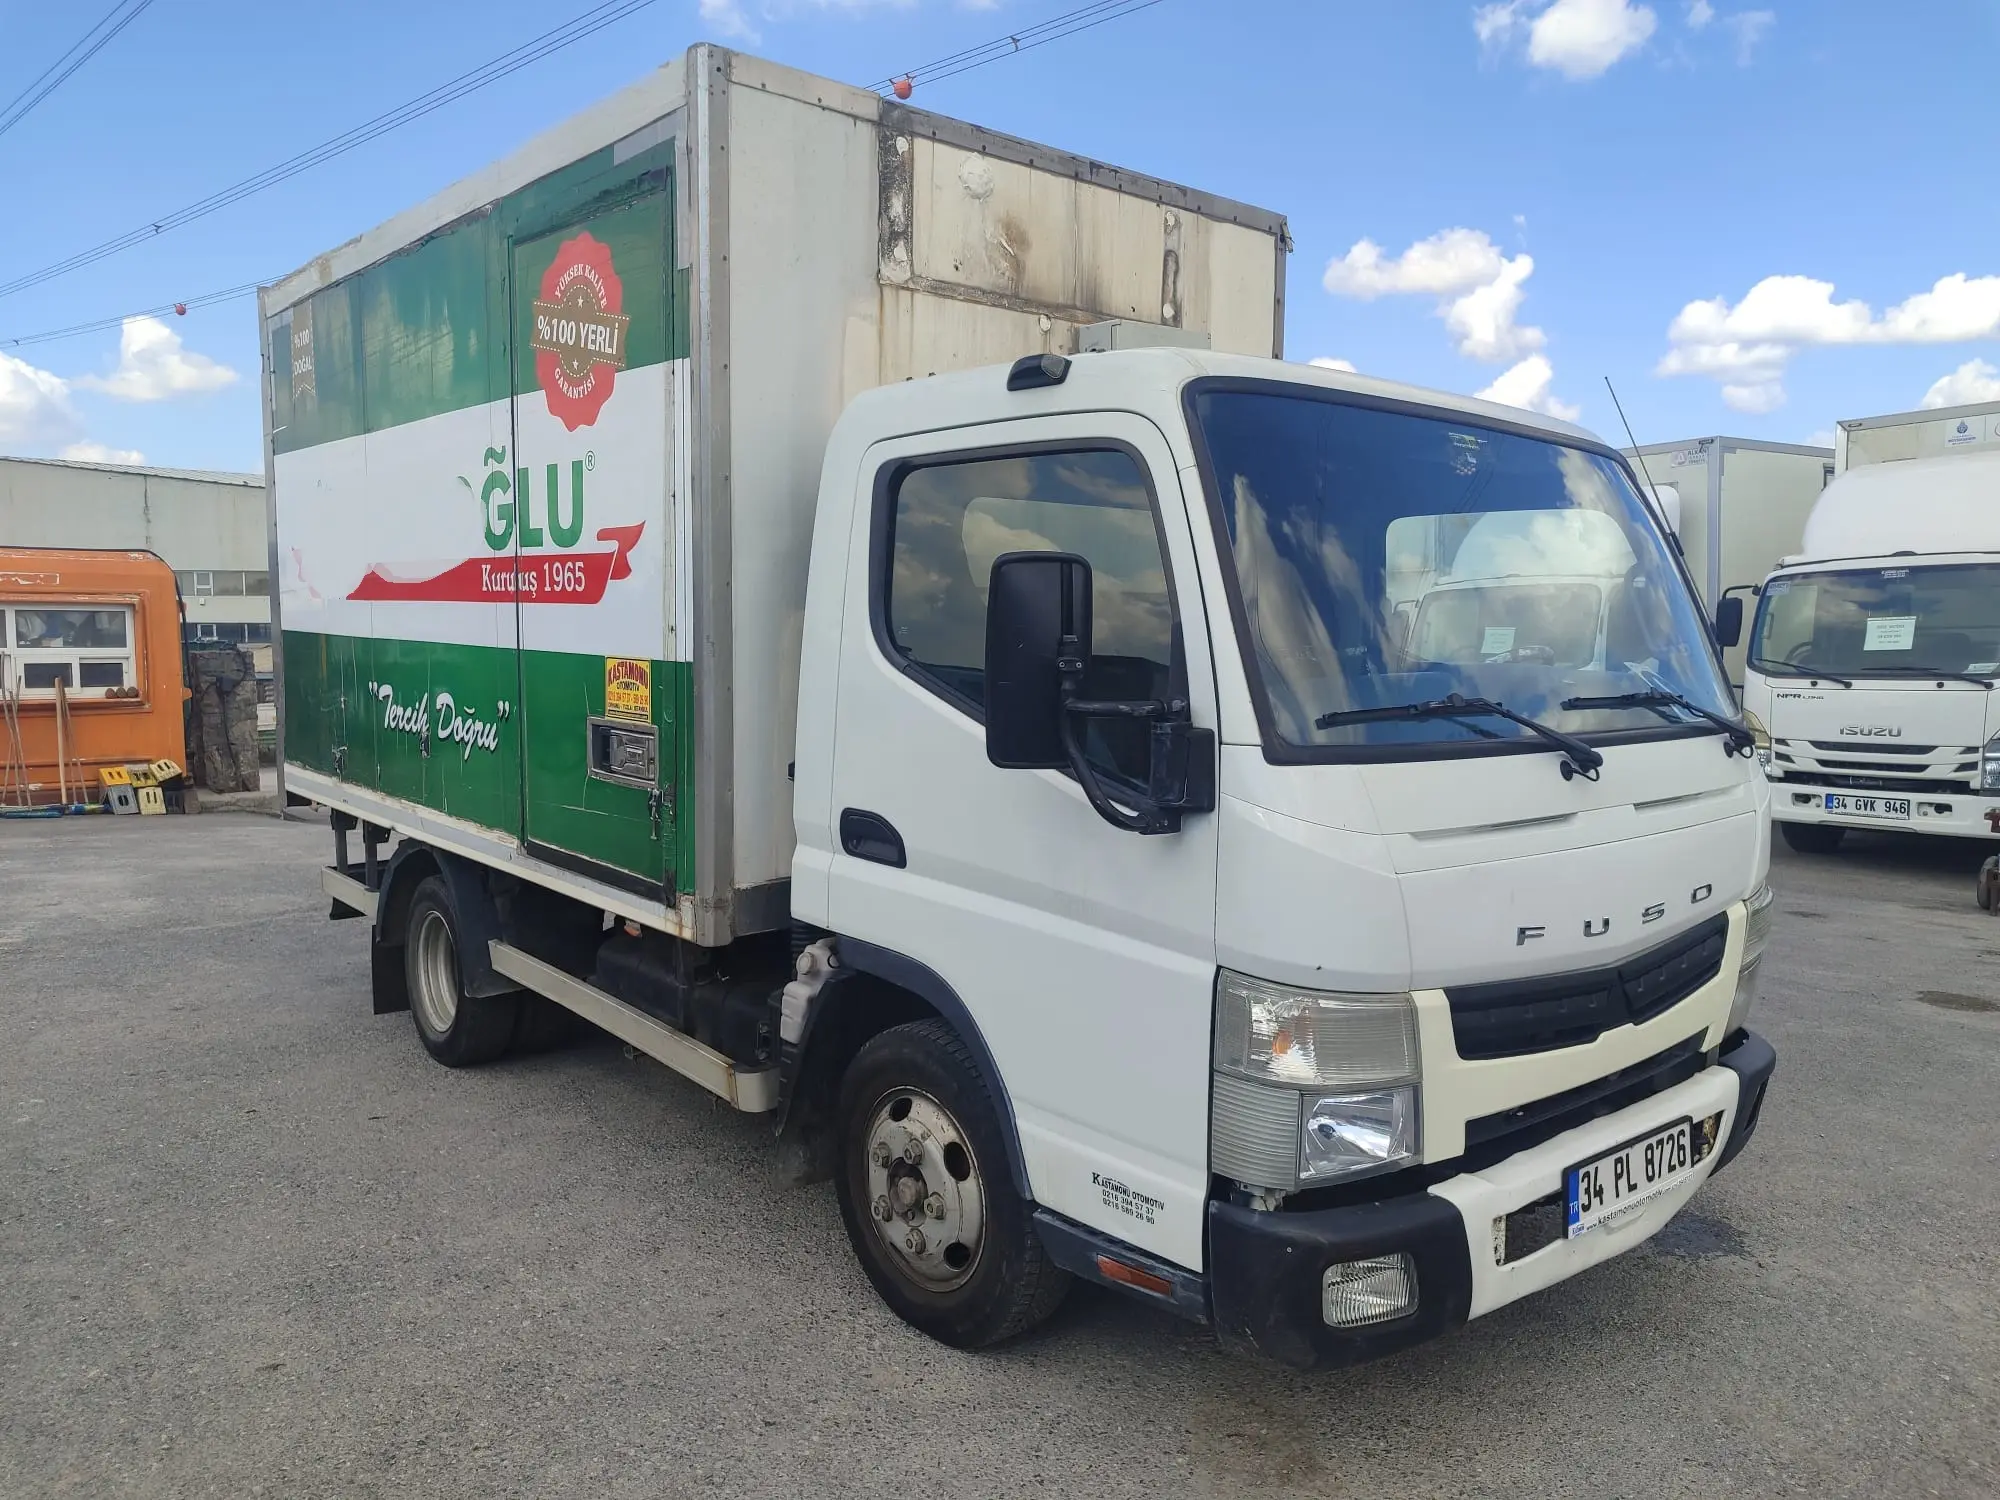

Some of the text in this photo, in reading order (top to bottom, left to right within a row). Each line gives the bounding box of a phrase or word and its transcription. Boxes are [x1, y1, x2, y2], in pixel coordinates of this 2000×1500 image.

[554, 263, 609, 310] YÜKSEK KALİTE
[537, 314, 619, 355] %100 YERLİ
[554, 367, 596, 400] GARANTİSİ
[543, 561, 585, 592] 1965
[607, 660, 649, 690] KASTAMONU
[1839, 725, 1902, 738] ISUZU
[1834, 797, 1907, 814] 34 GVK 946
[1516, 883, 1713, 946] FUSO
[1091, 1171, 1131, 1198] KASTAMONU
[1581, 1166, 1604, 1213] 34
[1614, 1152, 1638, 1199] PL
[1644, 1128, 1687, 1183] 8726
[1569, 1200, 1578, 1215] TR
